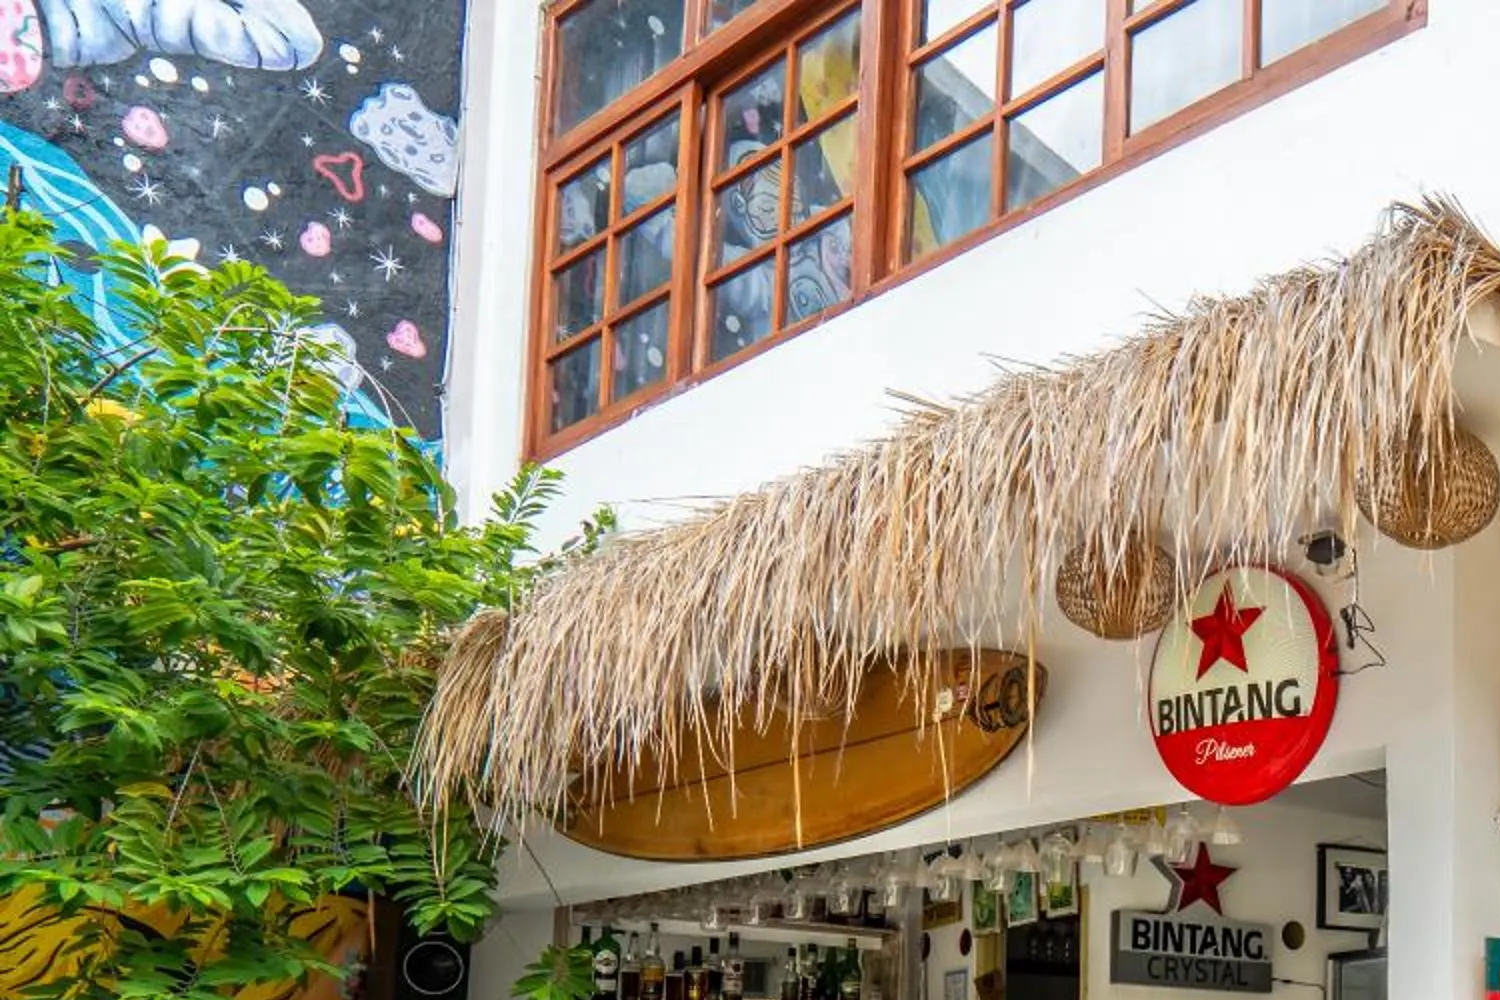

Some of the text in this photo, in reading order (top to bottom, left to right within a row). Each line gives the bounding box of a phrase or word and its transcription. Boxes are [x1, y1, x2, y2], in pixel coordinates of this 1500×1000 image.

[1158, 678, 1301, 736] BINTANG
[1195, 738, 1256, 766] Pilsener
[1131, 919, 1263, 959] BINTANG
[1147, 956, 1248, 987] CRYSTAL
